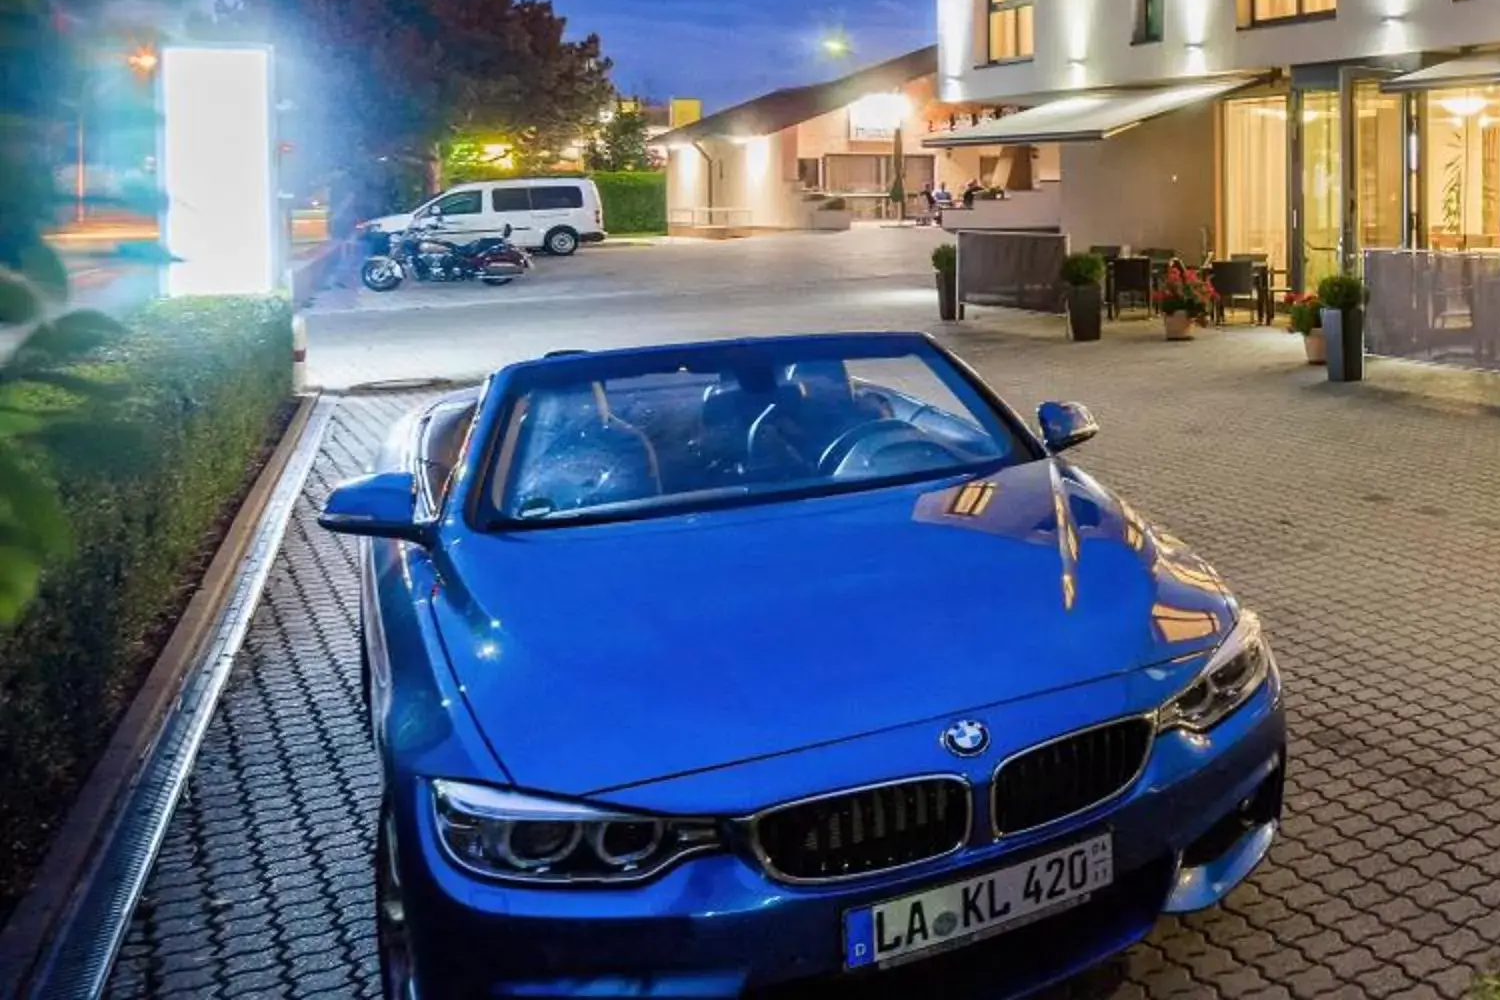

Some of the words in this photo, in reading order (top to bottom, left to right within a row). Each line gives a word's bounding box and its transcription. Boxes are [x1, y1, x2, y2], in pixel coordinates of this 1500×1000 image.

[876, 900, 929, 953] LA
[962, 879, 1011, 928] KL
[1023, 849, 1087, 904] 420
[855, 943, 866, 957] D
